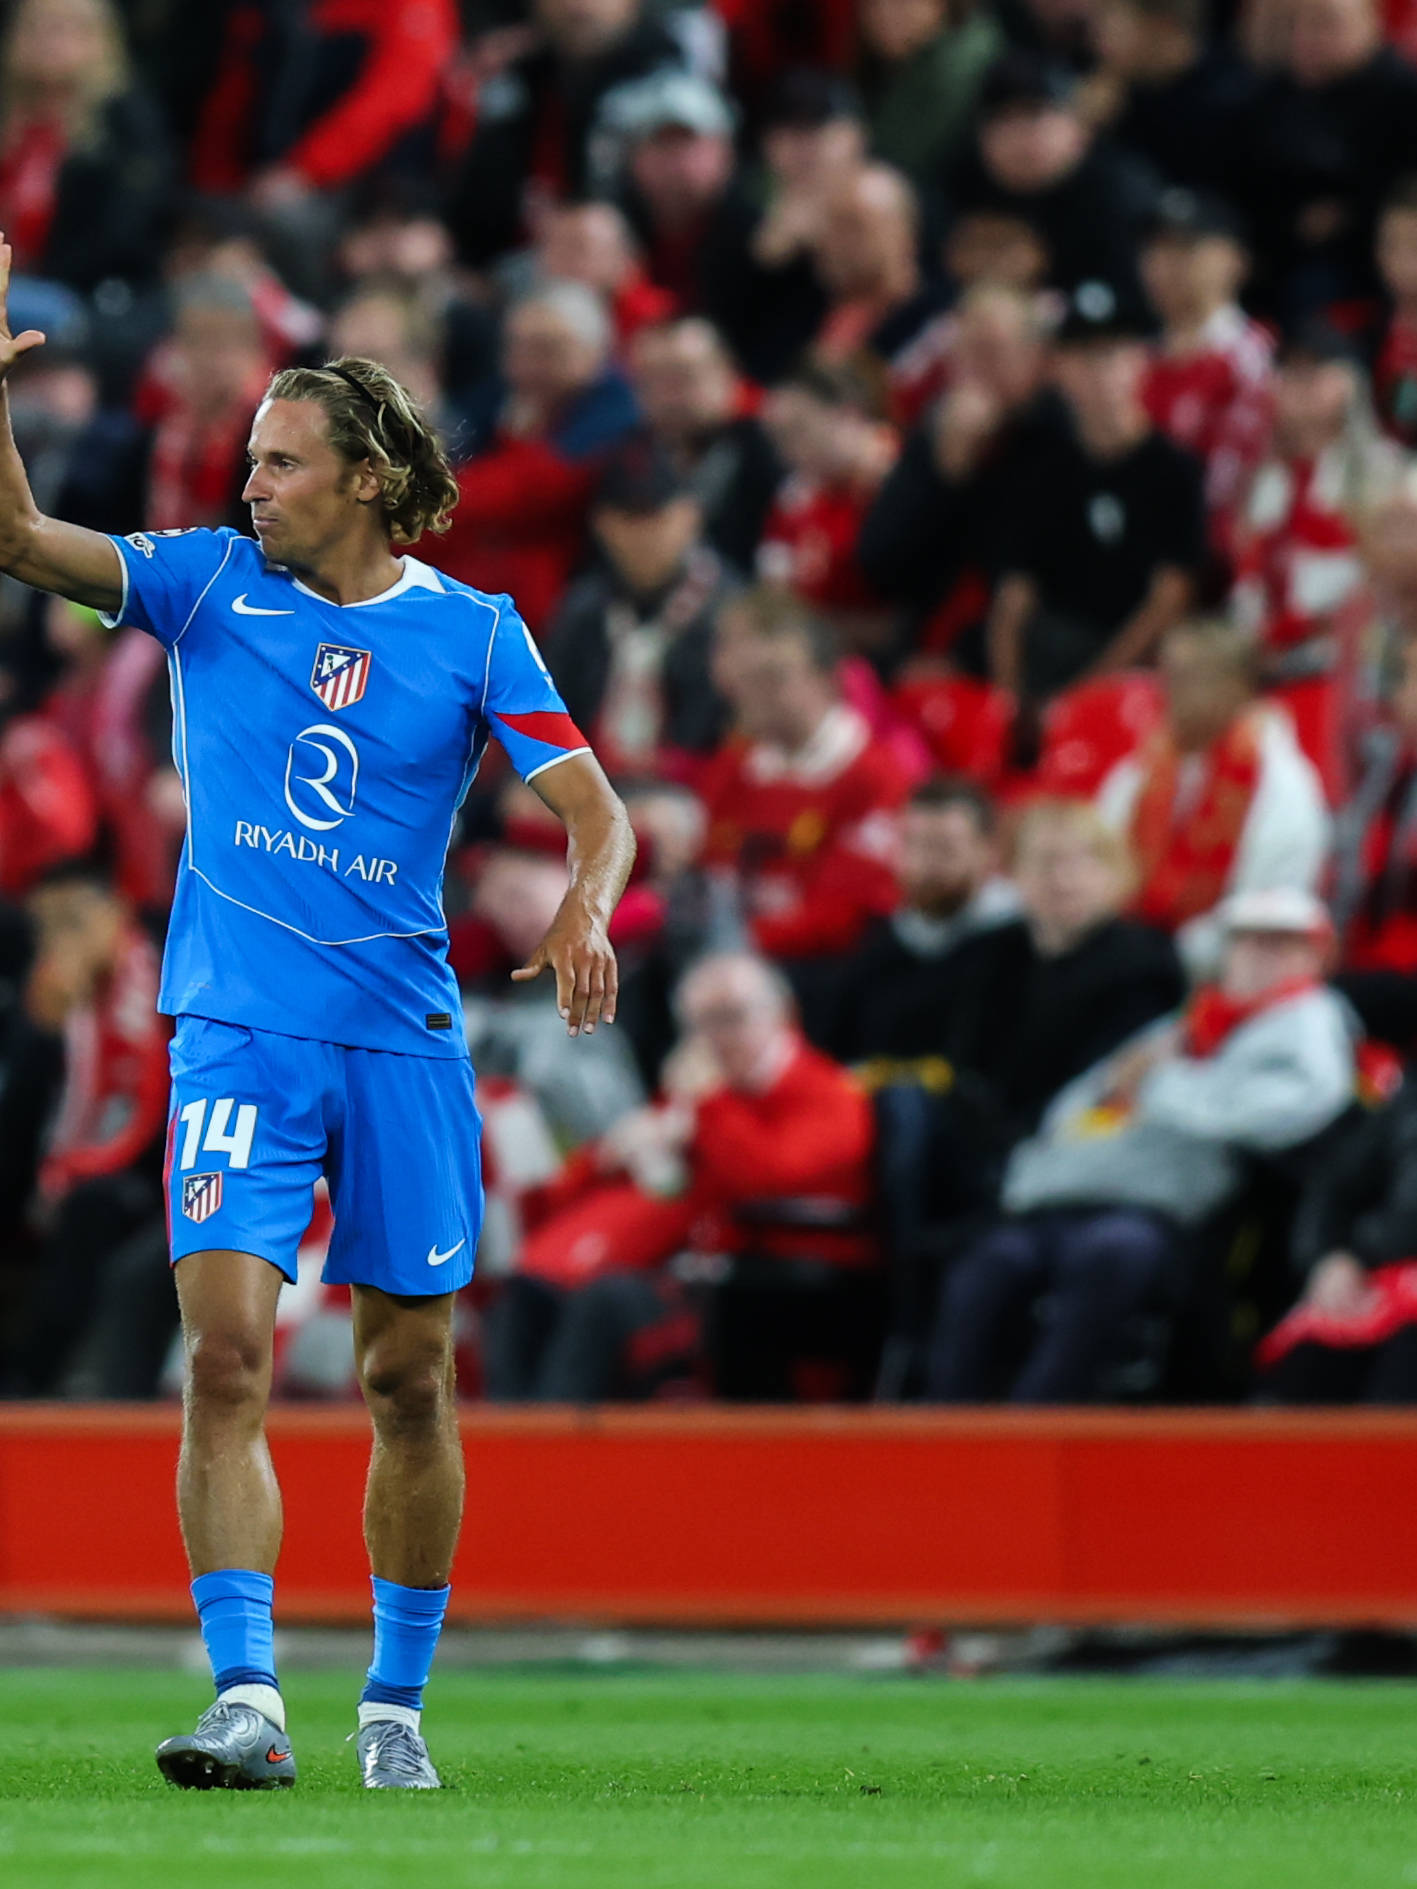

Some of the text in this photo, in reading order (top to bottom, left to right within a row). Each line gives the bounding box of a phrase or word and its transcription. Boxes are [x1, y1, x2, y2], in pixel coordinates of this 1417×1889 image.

[235, 820, 398, 886] RIYADH AIR
[180, 1098, 257, 1170] 14
